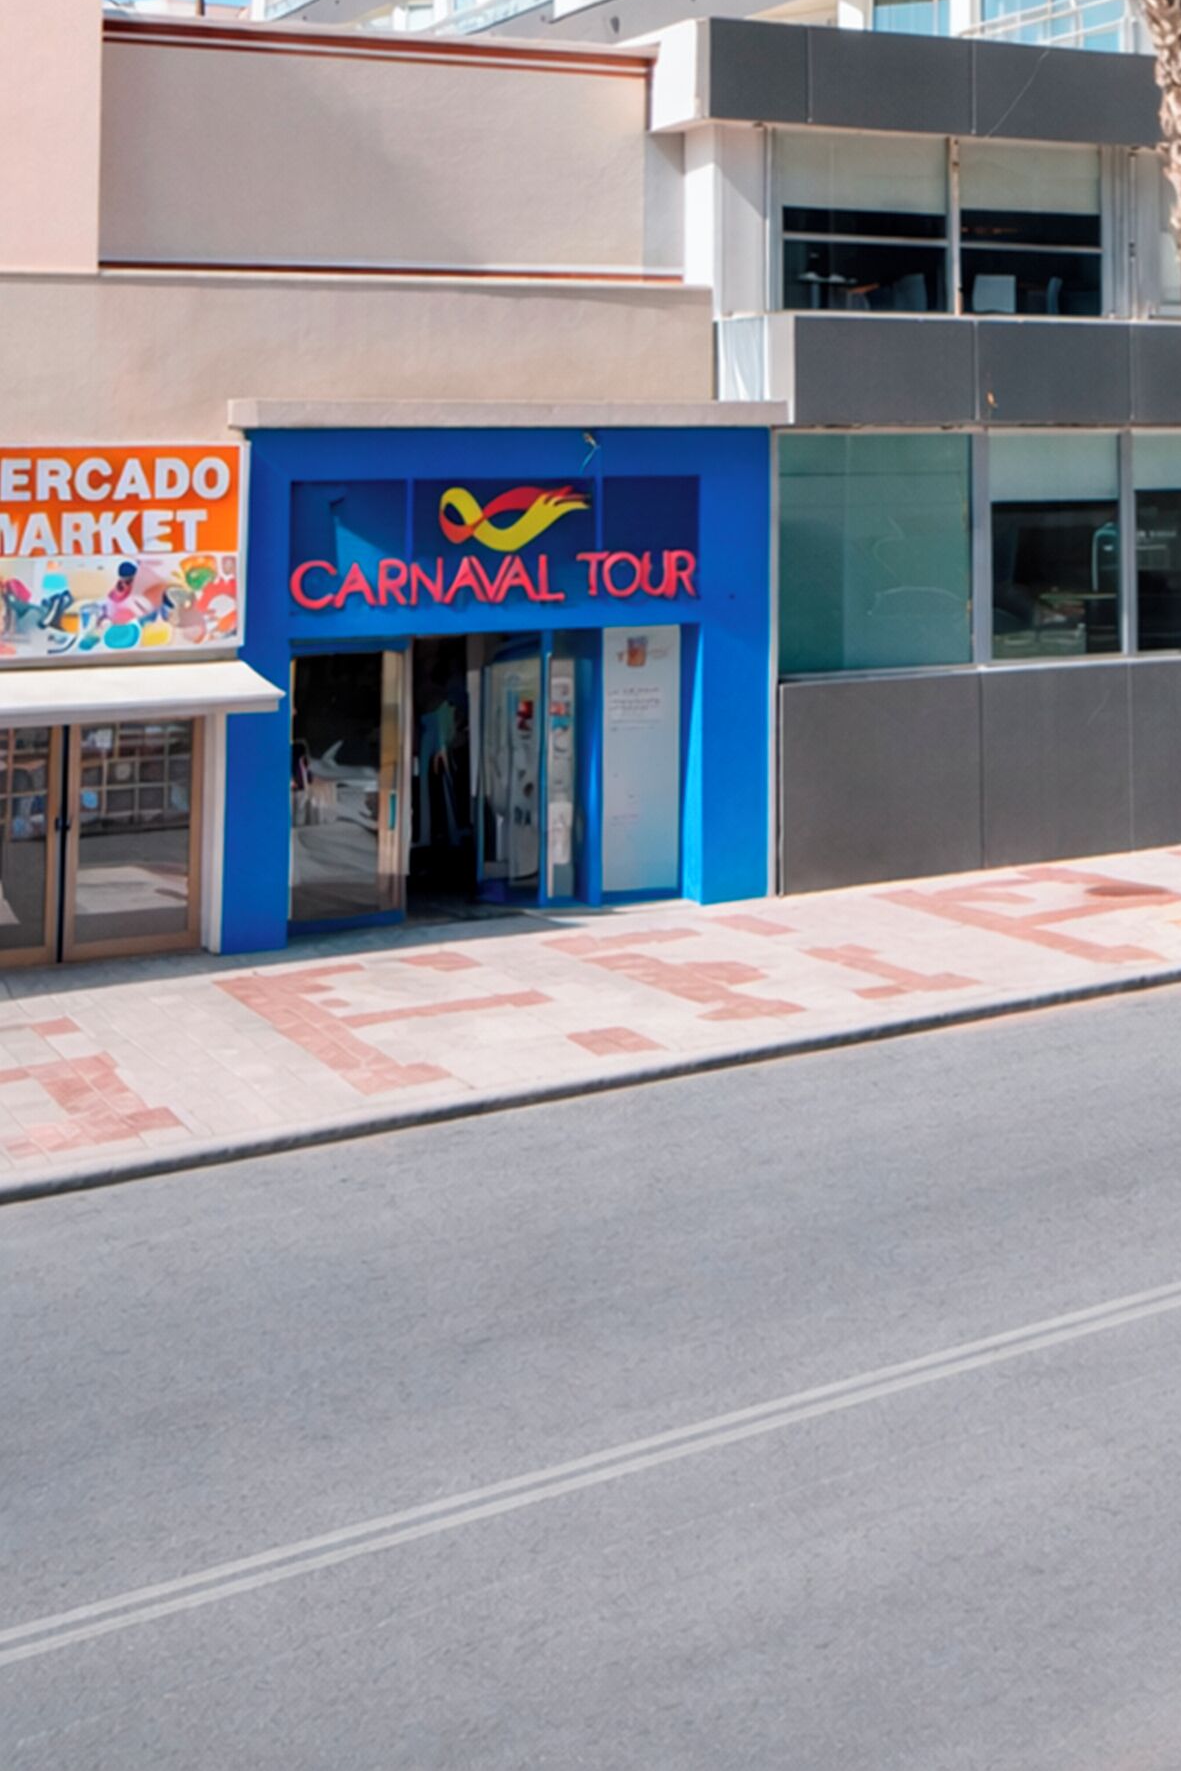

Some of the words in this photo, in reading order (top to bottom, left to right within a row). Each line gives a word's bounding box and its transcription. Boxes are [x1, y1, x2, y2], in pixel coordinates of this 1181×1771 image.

[0, 456, 230, 501] ERCADO
[289, 554, 566, 610] CARNAVAL
[576, 550, 697, 598] TOUR
